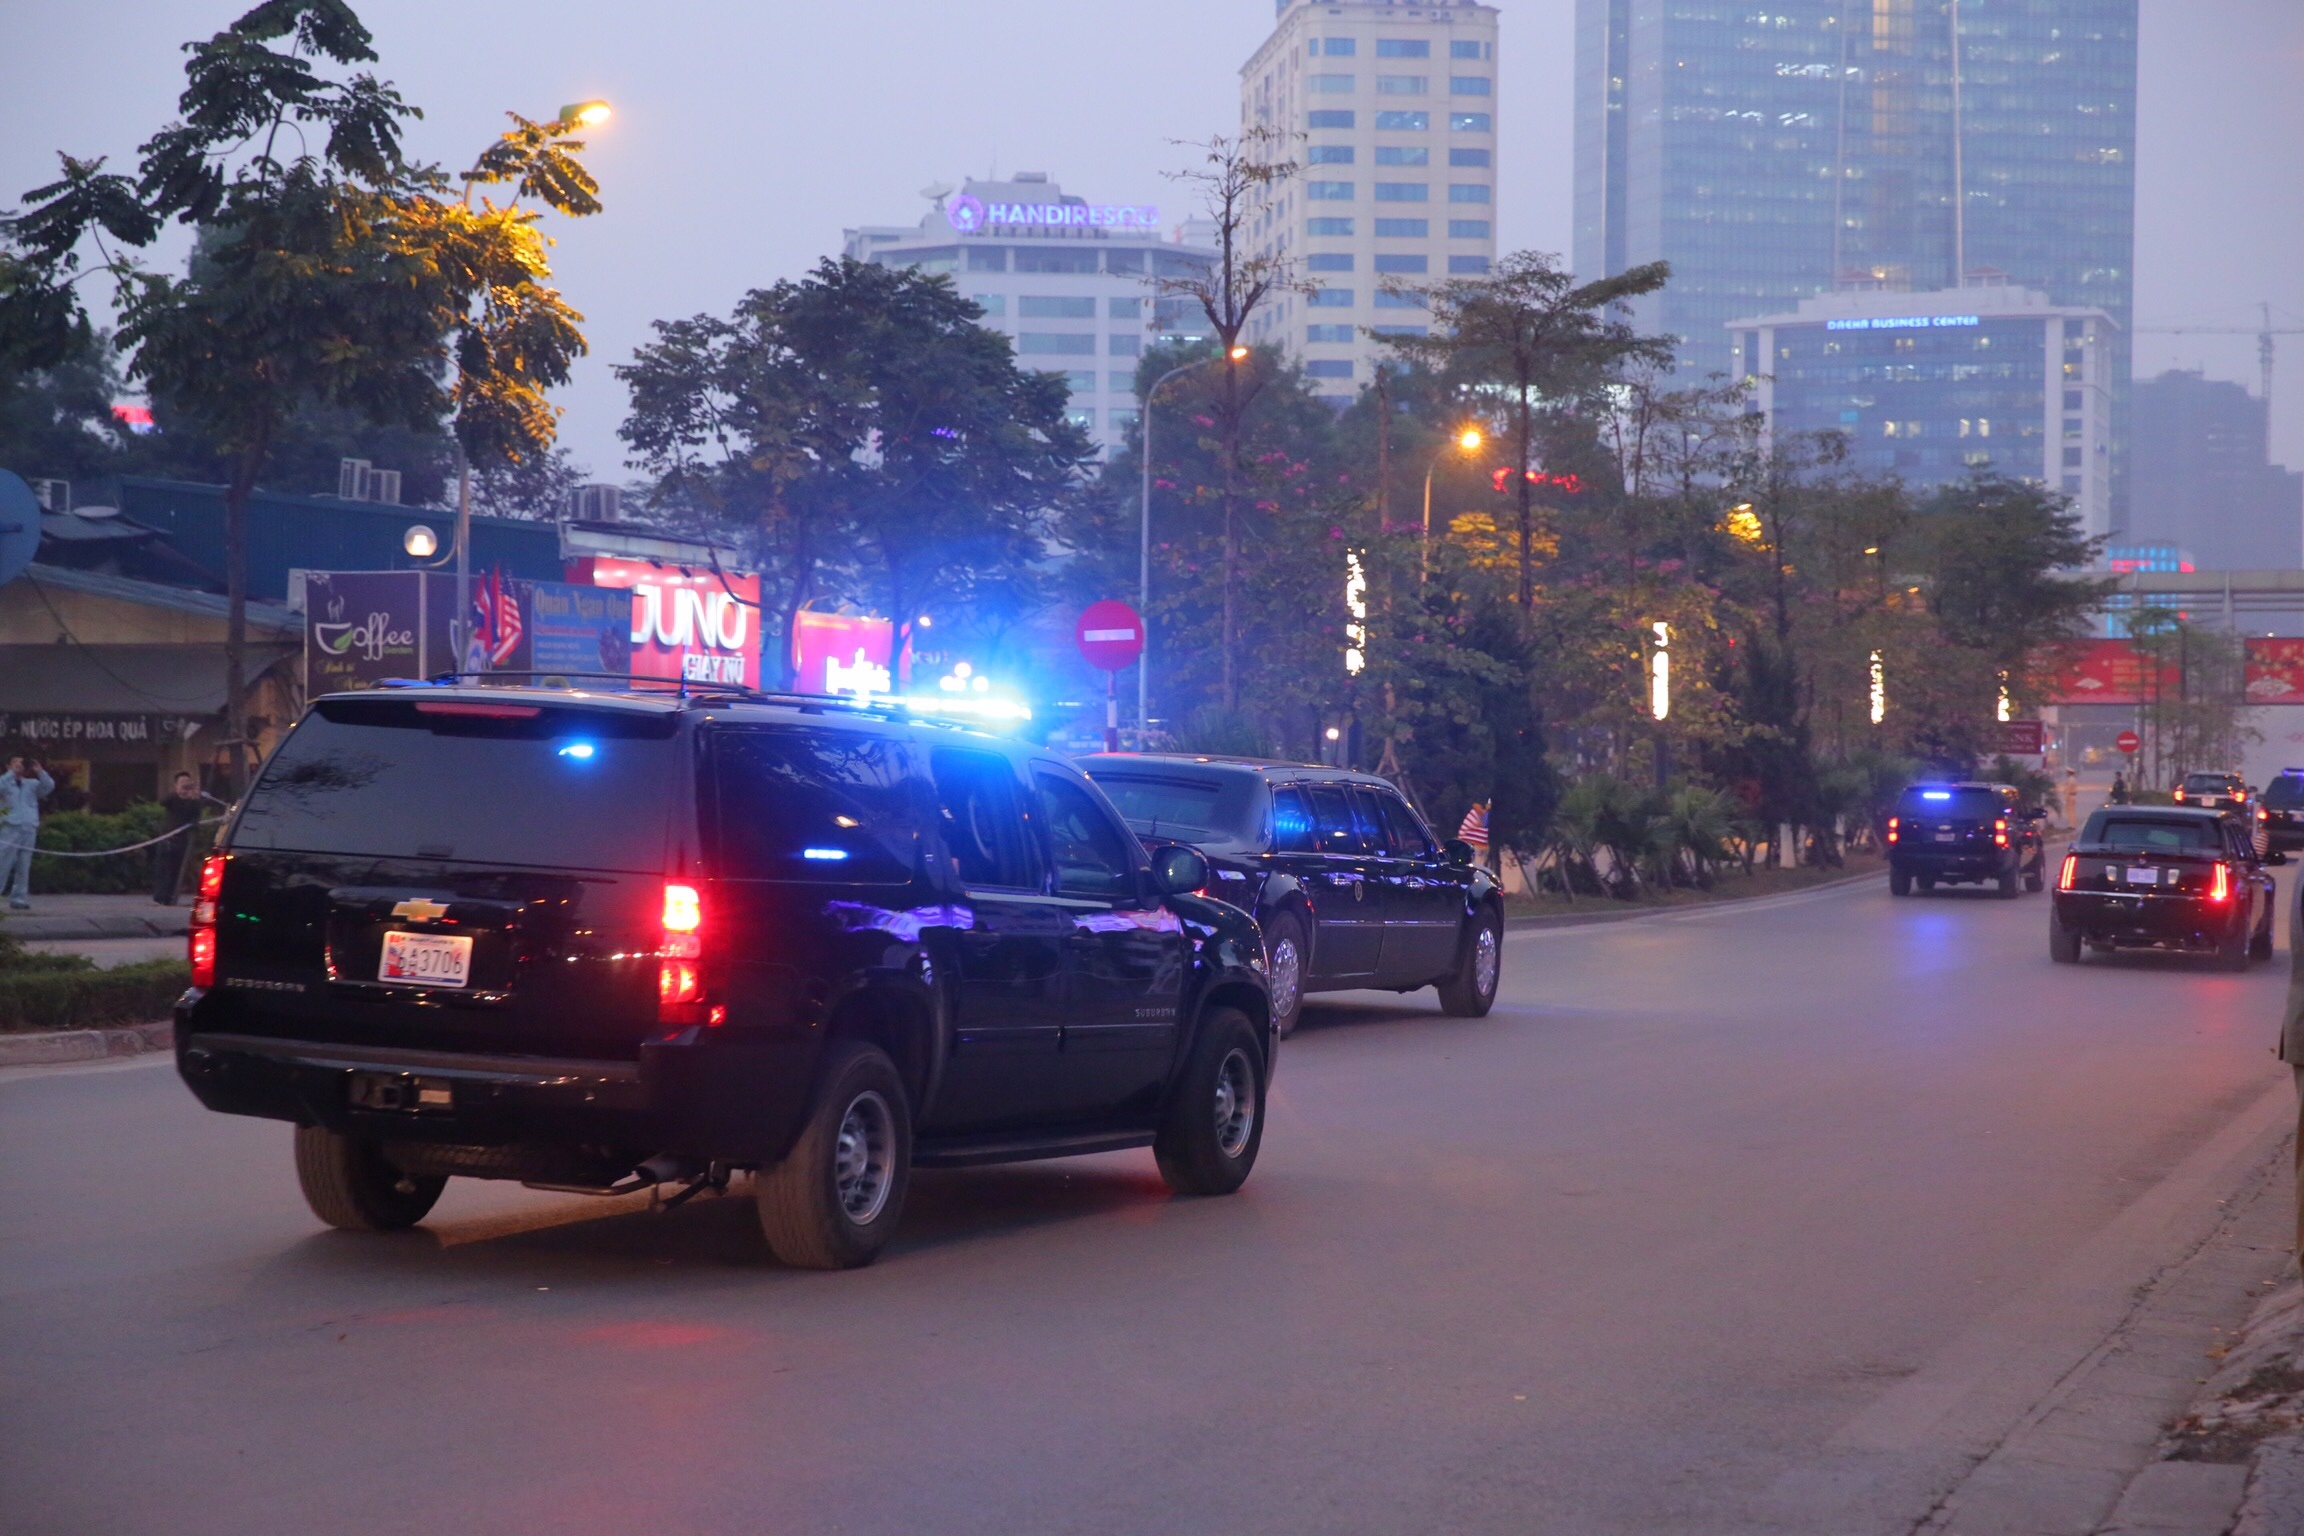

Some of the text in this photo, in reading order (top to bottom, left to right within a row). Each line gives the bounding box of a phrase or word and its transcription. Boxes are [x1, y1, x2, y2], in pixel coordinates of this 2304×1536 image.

[988, 203, 1160, 226] HANDIRESCO
[1871, 316, 1930, 329] BUSINESS
[1932, 315, 1979, 327] CENTER
[631, 584, 747, 650] JUNO
[86, 720, 115, 739] HOA
